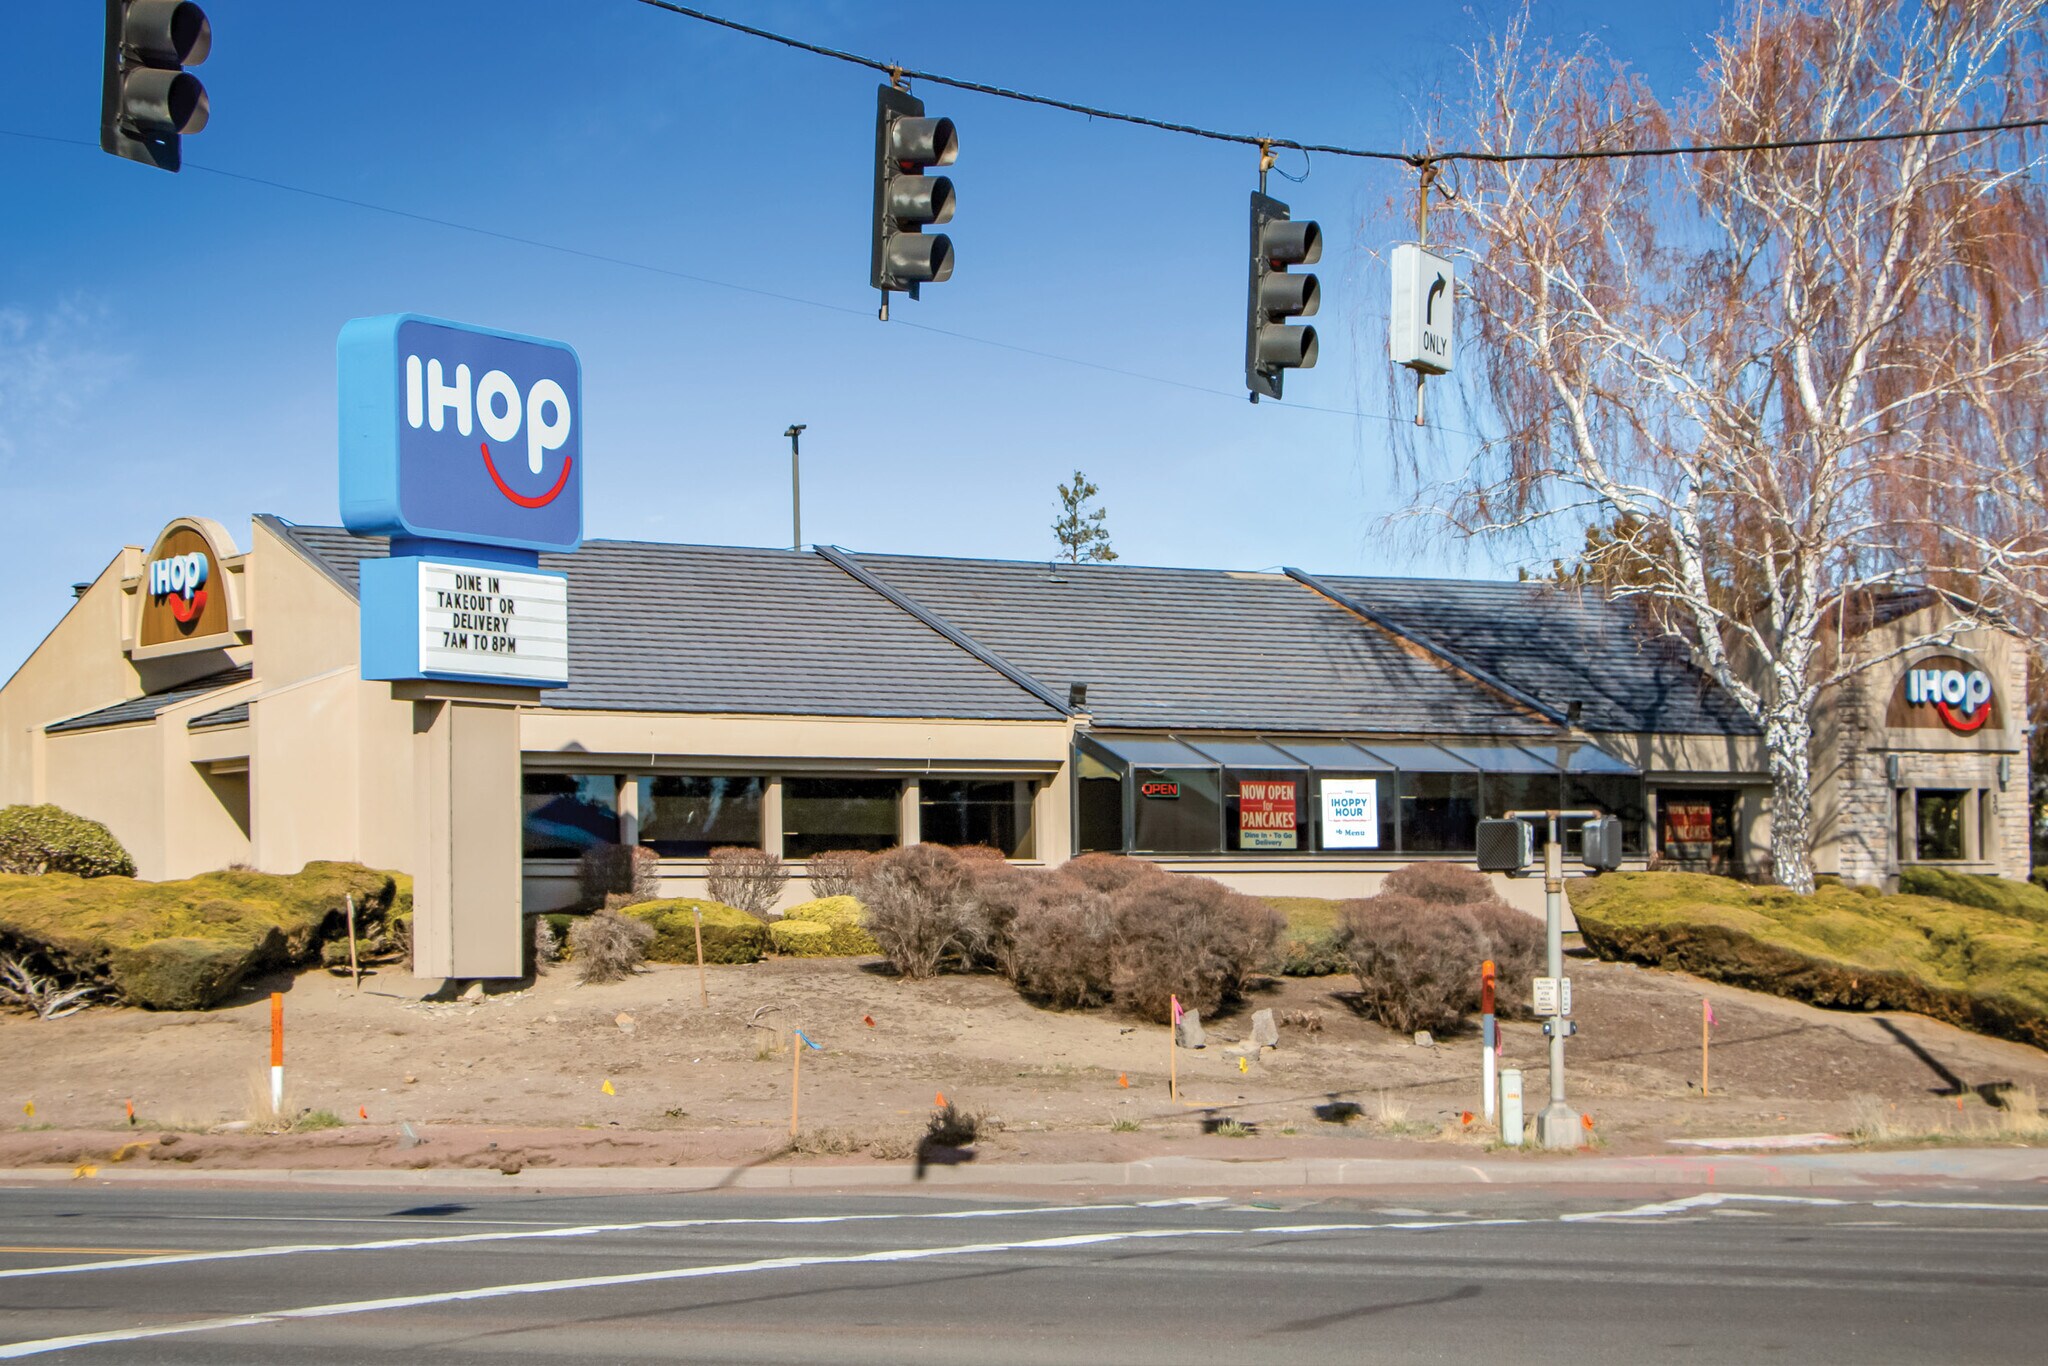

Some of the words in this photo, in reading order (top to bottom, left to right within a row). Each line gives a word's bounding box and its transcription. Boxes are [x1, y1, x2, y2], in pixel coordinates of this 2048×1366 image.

[1423, 331, 1447, 356] ONLY
[406, 354, 571, 475] IHOP
[150, 552, 208, 600] IHOP
[456, 573, 482, 592] DINE
[488, 576, 500, 594] IN
[437, 591, 493, 613] TAKEOUT
[499, 598, 515, 615] OR
[453, 612, 509, 633] DELIVERY
[443, 631, 468, 649] 7AM
[473, 634, 488, 651] TO
[491, 636, 516, 654] 8PM
[1906, 669, 1991, 714] IHOP
[1141, 783, 1177, 795] OPEN
[1241, 784, 1266, 800] NOW
[1267, 784, 1294, 800] OPEN
[1262, 800, 1273, 811] for
[1331, 798, 1368, 807] IHOPPY
[1335, 807, 1363, 817] HOUR
[1241, 811, 1295, 828] PANCAKES
[1344, 829, 1366, 837] Menu
